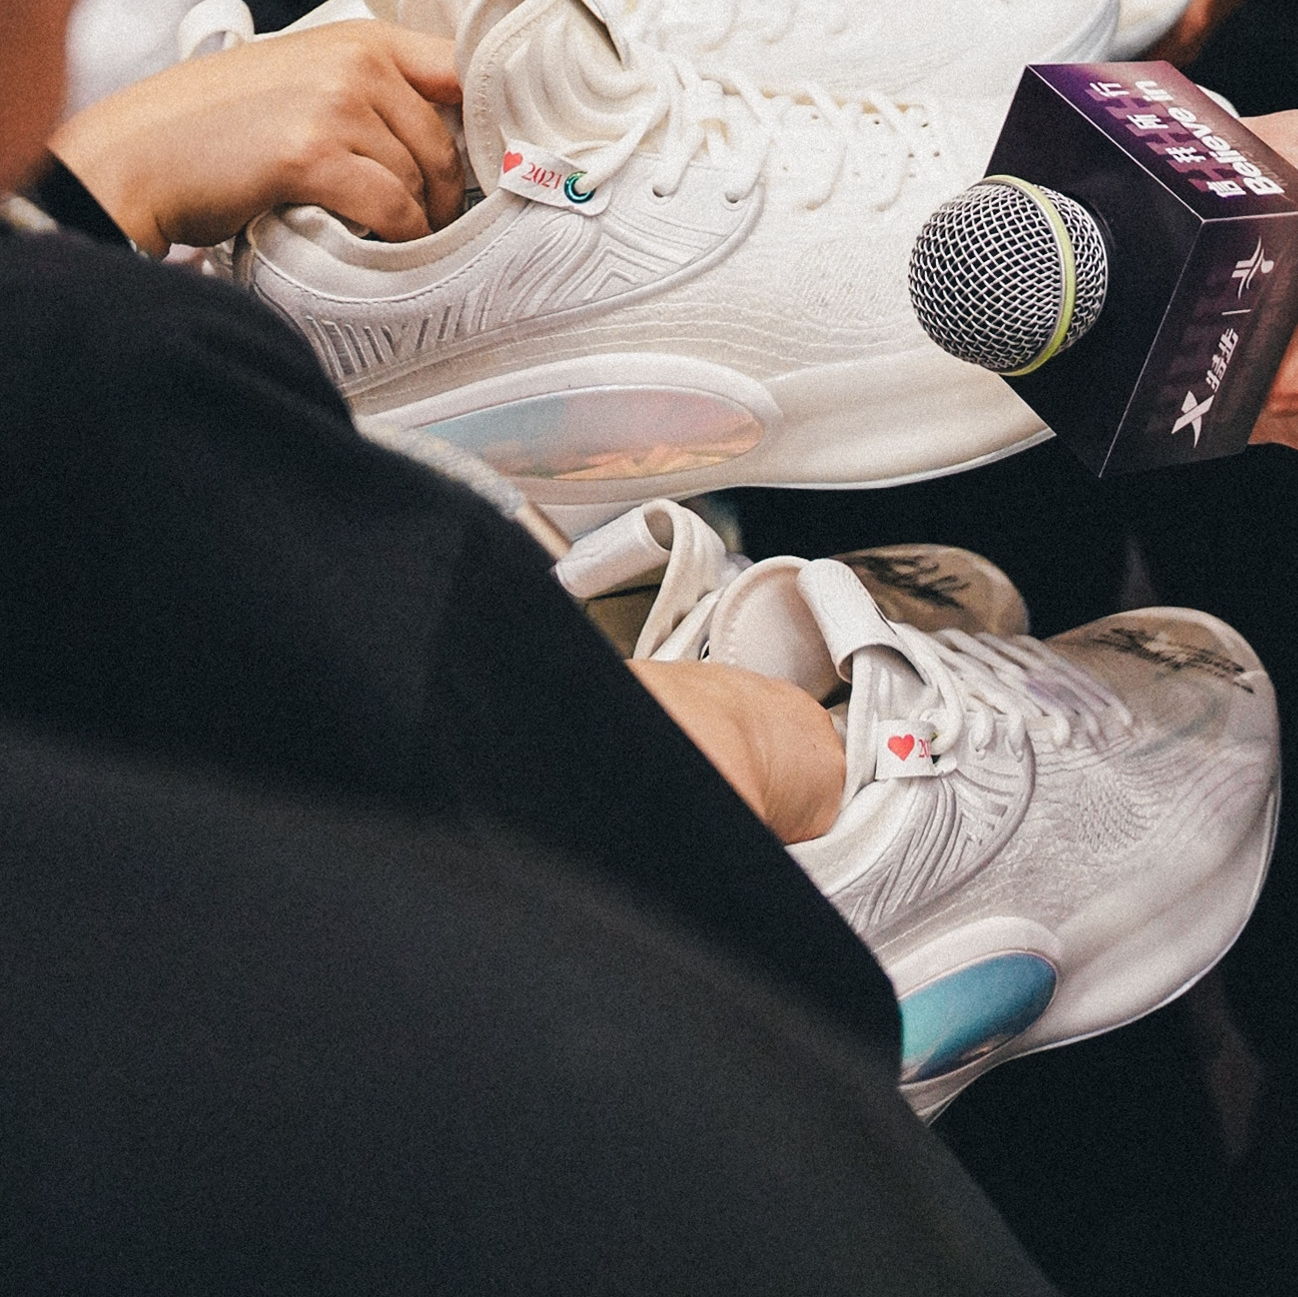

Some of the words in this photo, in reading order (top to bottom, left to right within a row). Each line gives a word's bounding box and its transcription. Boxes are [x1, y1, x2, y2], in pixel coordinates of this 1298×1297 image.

[1133, 79, 1175, 105] in
[1169, 104, 1286, 197] Believe
[521, 162, 563, 189] 2021
